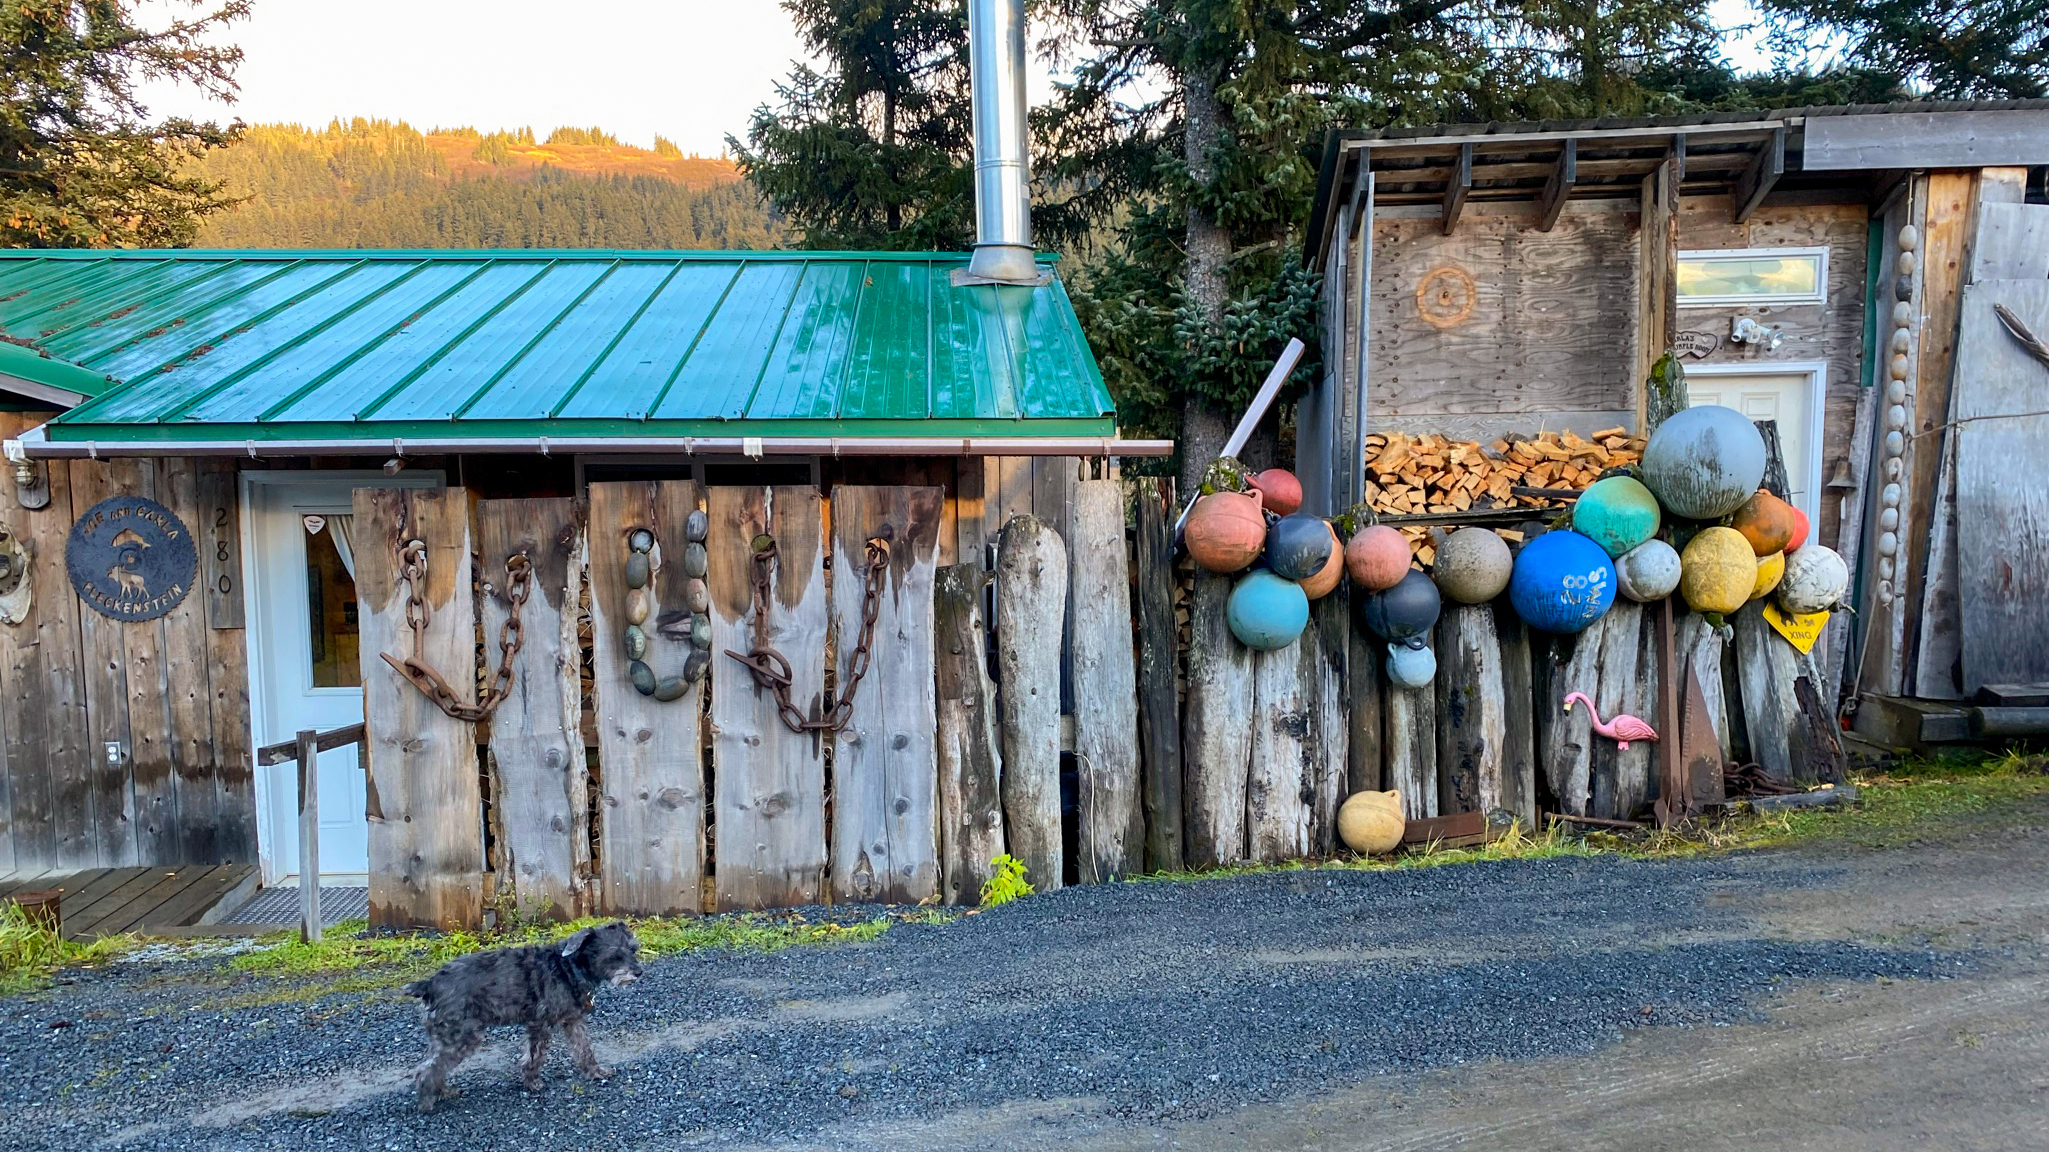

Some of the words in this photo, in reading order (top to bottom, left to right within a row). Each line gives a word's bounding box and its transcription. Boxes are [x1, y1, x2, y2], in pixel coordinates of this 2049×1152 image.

[136, 505, 179, 540] CARLA
[215, 507, 232, 594] 280
[82, 581, 182, 614] FLECKENSTEIN
[1561, 574, 1588, 606] 28
[1789, 631, 1813, 640] XING
